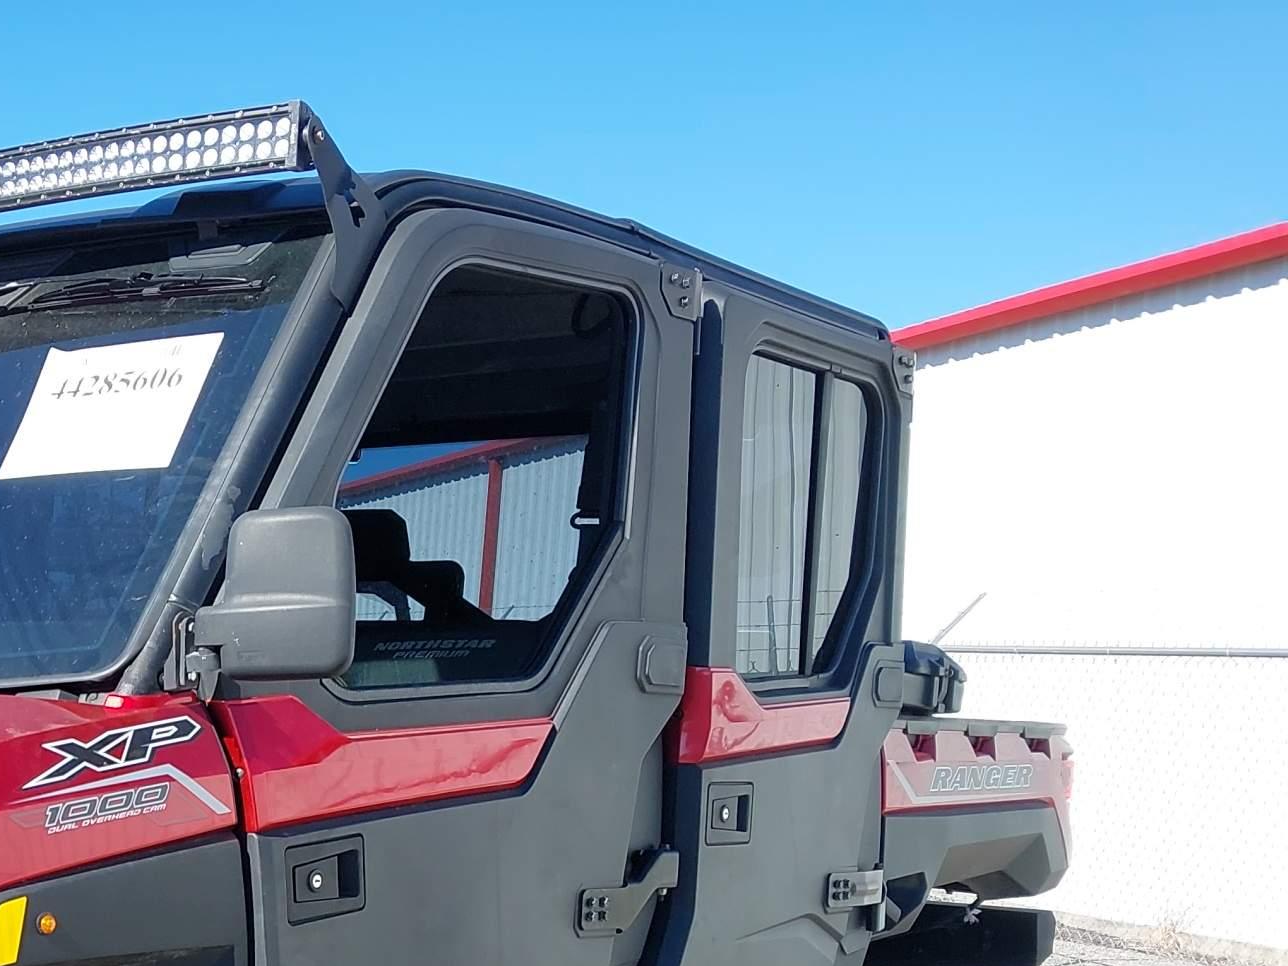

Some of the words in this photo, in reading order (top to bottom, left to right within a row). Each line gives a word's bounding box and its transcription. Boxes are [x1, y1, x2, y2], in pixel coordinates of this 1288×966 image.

[51, 368, 184, 399] 44285606
[374, 639, 496, 651] NORTHSTAR
[393, 650, 470, 660] PREMIUM
[21, 716, 202, 790] XP
[930, 764, 1033, 792] RANGER
[45, 782, 170, 828] 1000
[47, 821, 79, 834] DUAL
[81, 809, 142, 827] OVERHEAD
[142, 803, 167, 814] CAM
